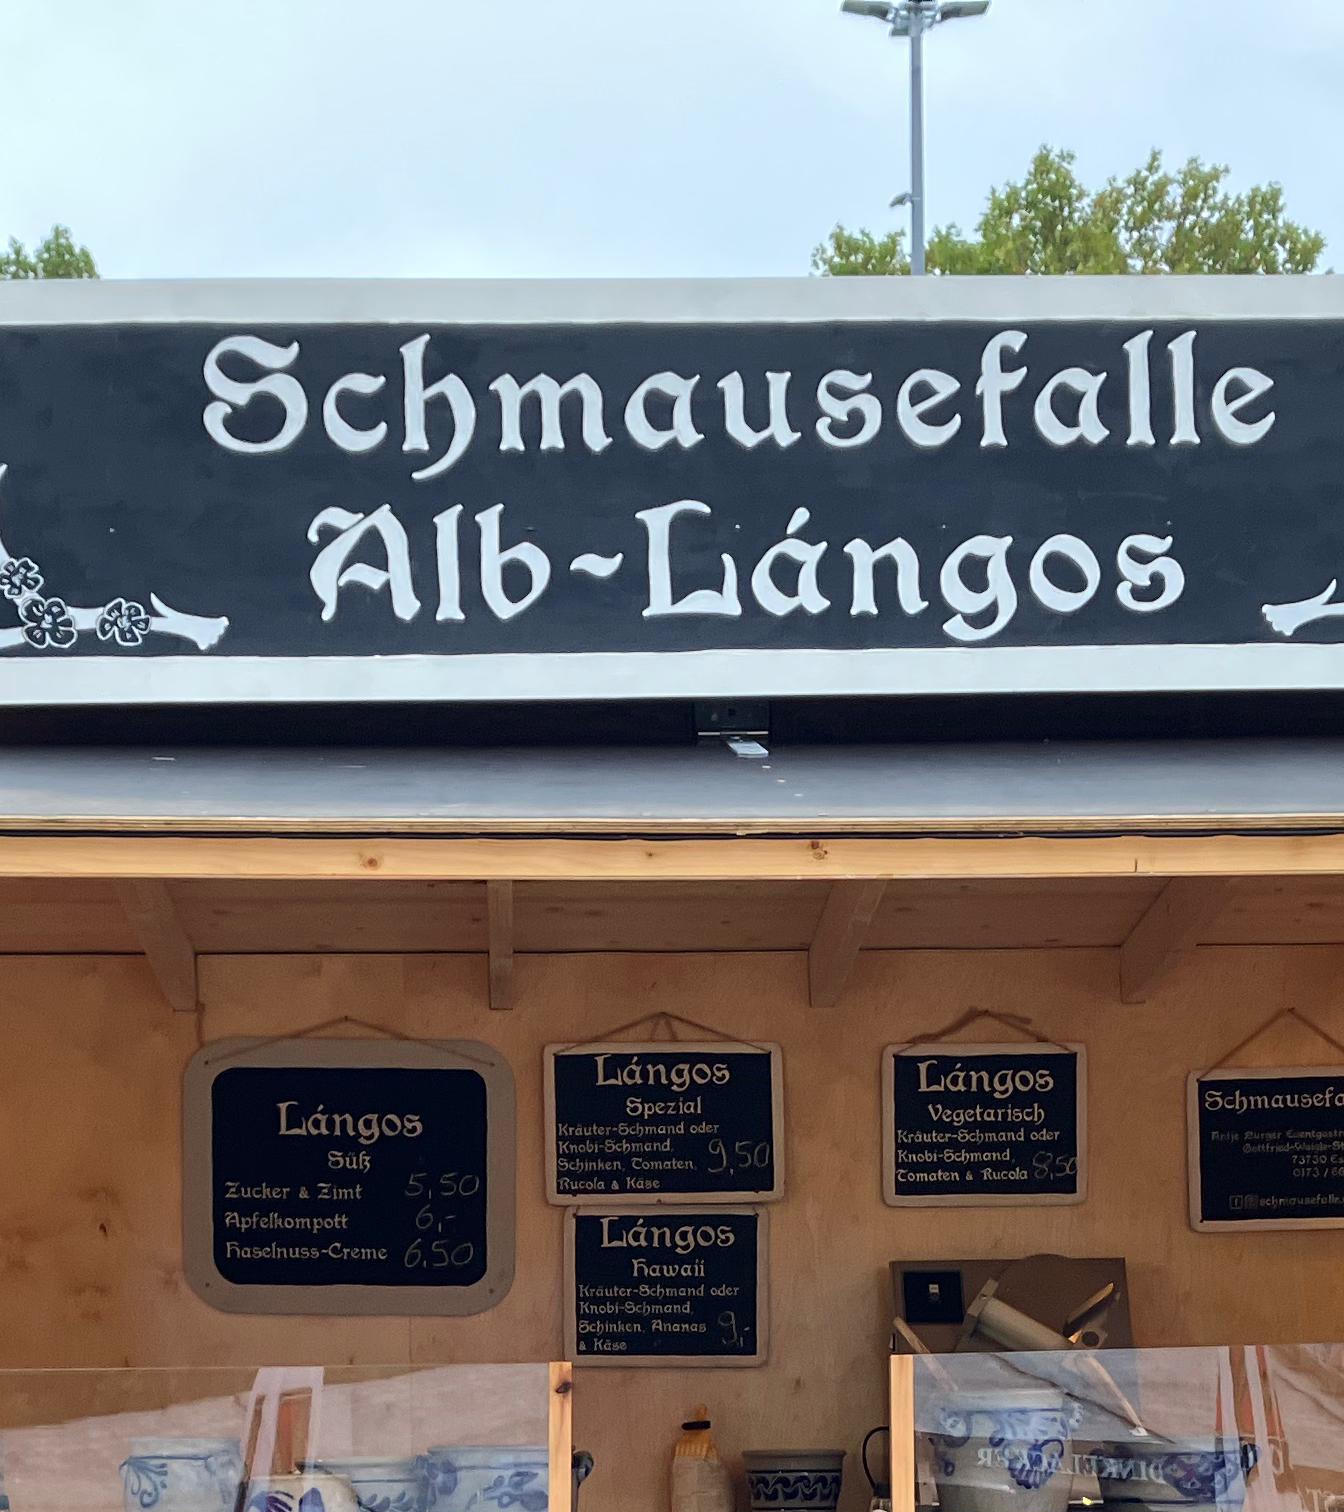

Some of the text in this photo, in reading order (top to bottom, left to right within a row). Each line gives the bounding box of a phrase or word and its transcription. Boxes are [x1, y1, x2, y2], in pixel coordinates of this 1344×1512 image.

[203, 330, 1277, 482] Schmausefalle
[307, 497, 1187, 645] Alb-Lángos
[594, 1055, 730, 1091] Lángos
[916, 1060, 1054, 1098] Lángos
[626, 1096, 702, 1119] Spezial
[928, 1103, 1045, 1125] Vegetarisch
[277, 1101, 423, 1145] Lángos
[559, 1122, 720, 1137] Kräuter-Schmand oder
[897, 1128, 1060, 1145] Kräuter-Schmand oder
[328, 1151, 371, 1172] Süß
[708, 1139, 770, 1176] 9,50
[896, 1151, 1077, 1182] Tomaten & Rucola 8,50
[1291, 1155, 1327, 1164] 73730
[1293, 1167, 1320, 1177] 0173
[225, 1173, 479, 1200] Zucker & Zimt 5,50
[558, 1177, 660, 1190] Rucola & Käse
[225, 1212, 348, 1233] Apfelkompott
[600, 1217, 735, 1253] Lángos
[226, 1239, 474, 1268] Haselnuss-Creme 6,50
[631, 1259, 705, 1277] Hawaii
[579, 1285, 740, 1298] Kräuter-Schmand oder
[579, 1339, 627, 1351] & Käse
